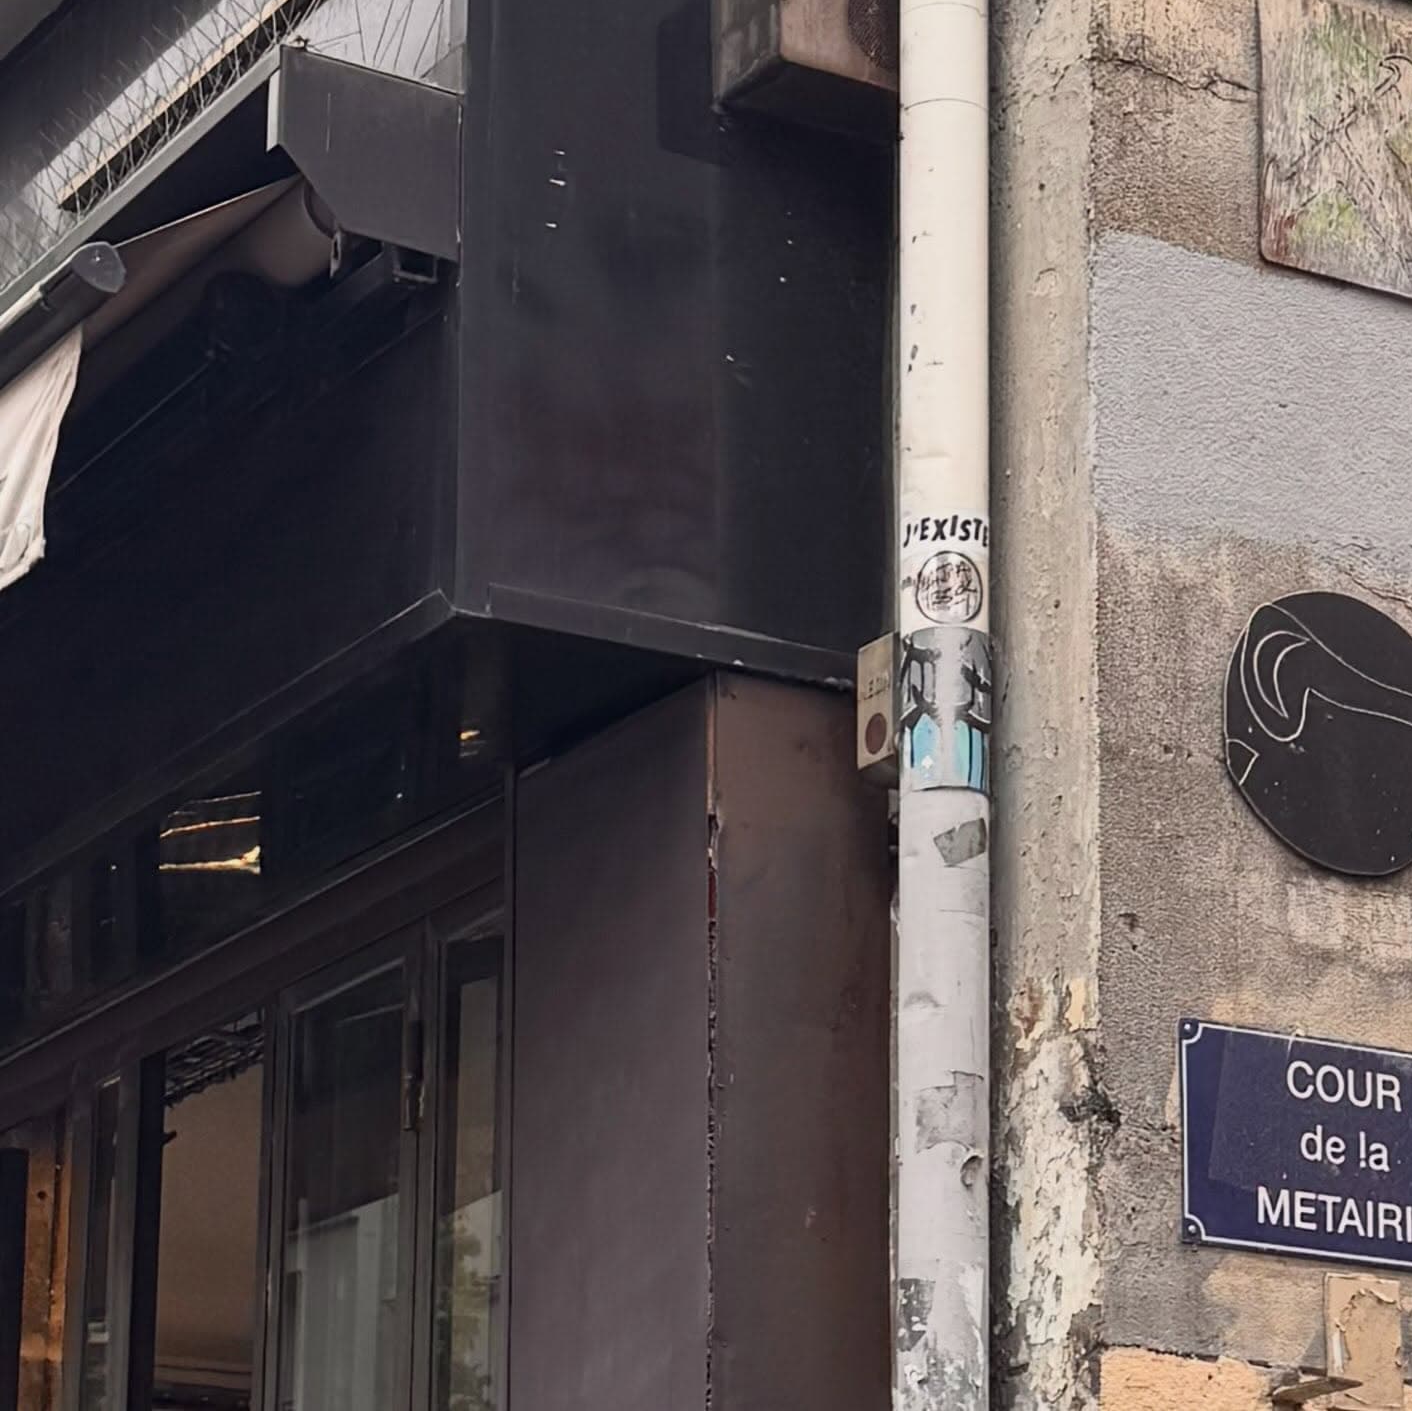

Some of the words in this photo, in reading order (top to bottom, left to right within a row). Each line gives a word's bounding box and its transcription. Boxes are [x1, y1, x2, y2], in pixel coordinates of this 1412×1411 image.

[1286, 1060, 1402, 1112] COUR
[1300, 1124, 1346, 1165] de
[1359, 1131, 1391, 1173] la
